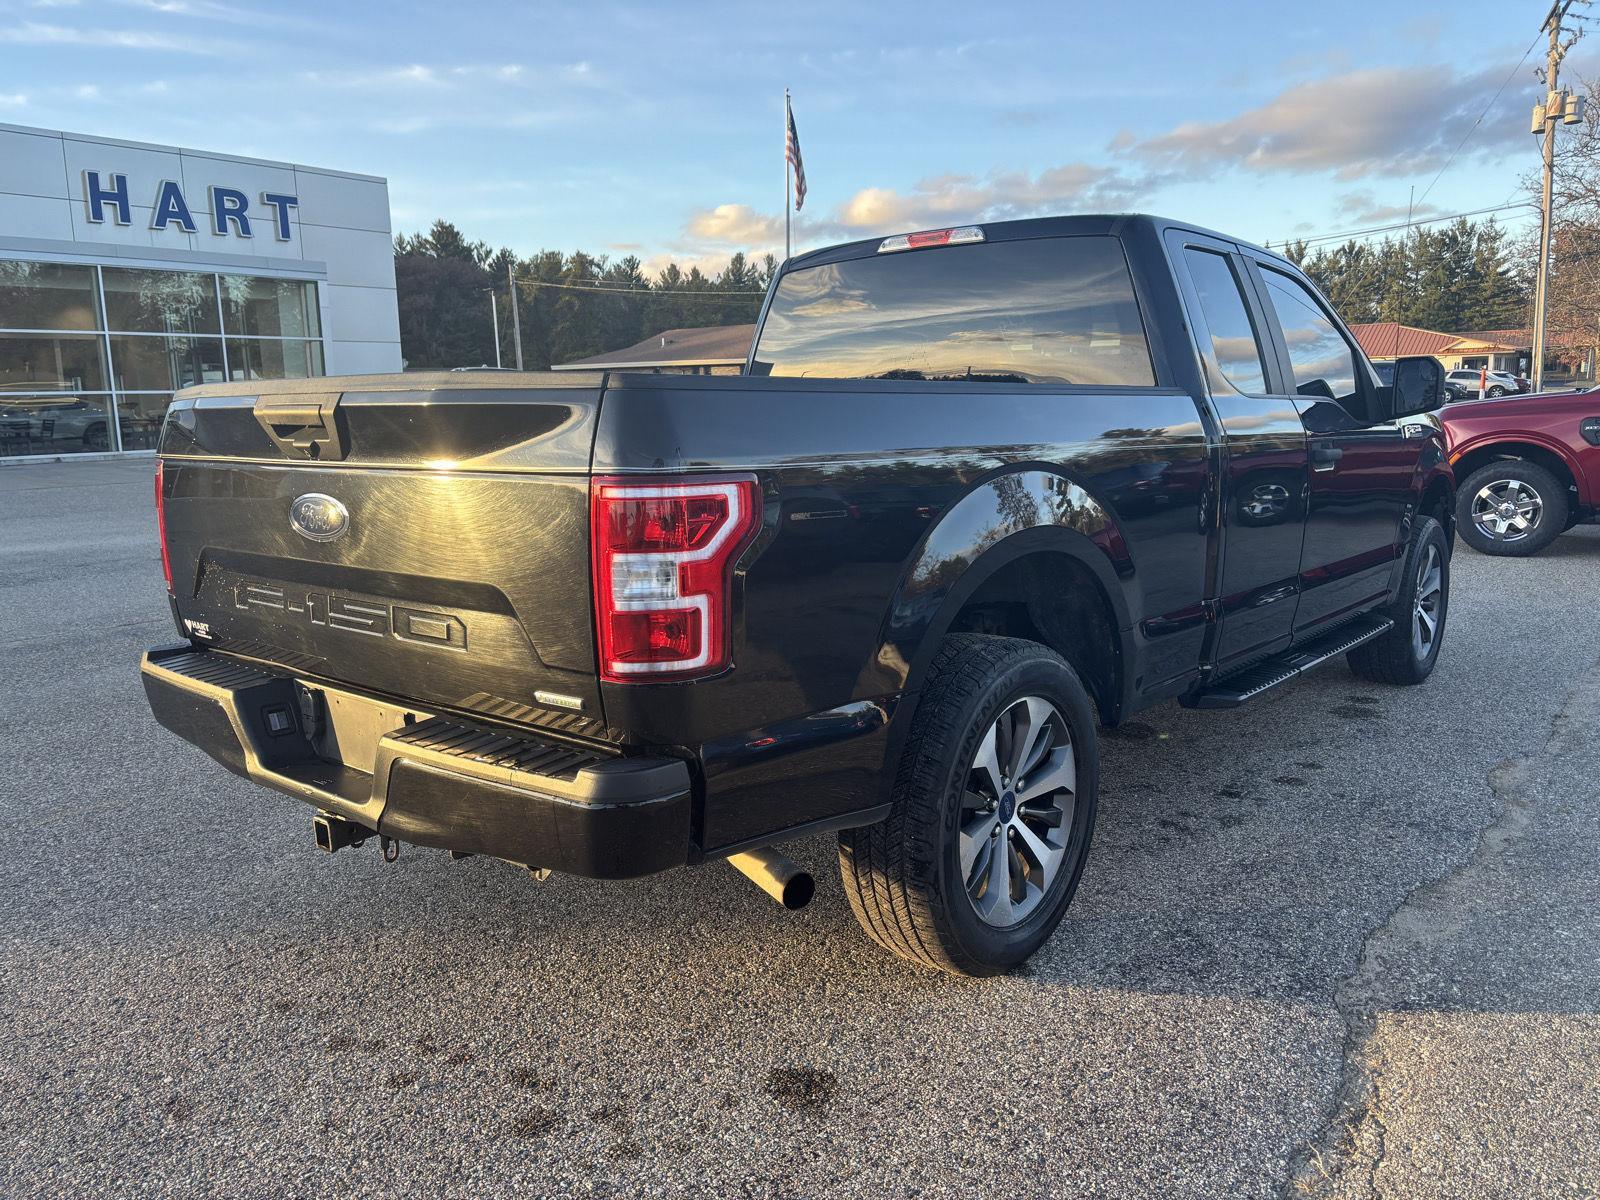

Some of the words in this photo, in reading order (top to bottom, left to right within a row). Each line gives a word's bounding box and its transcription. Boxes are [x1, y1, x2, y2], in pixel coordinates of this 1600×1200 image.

[84, 170, 299, 241] HART
[300, 502, 334, 531] Ford
[191, 620, 210, 632] HART
[234, 582, 468, 653] F-150
